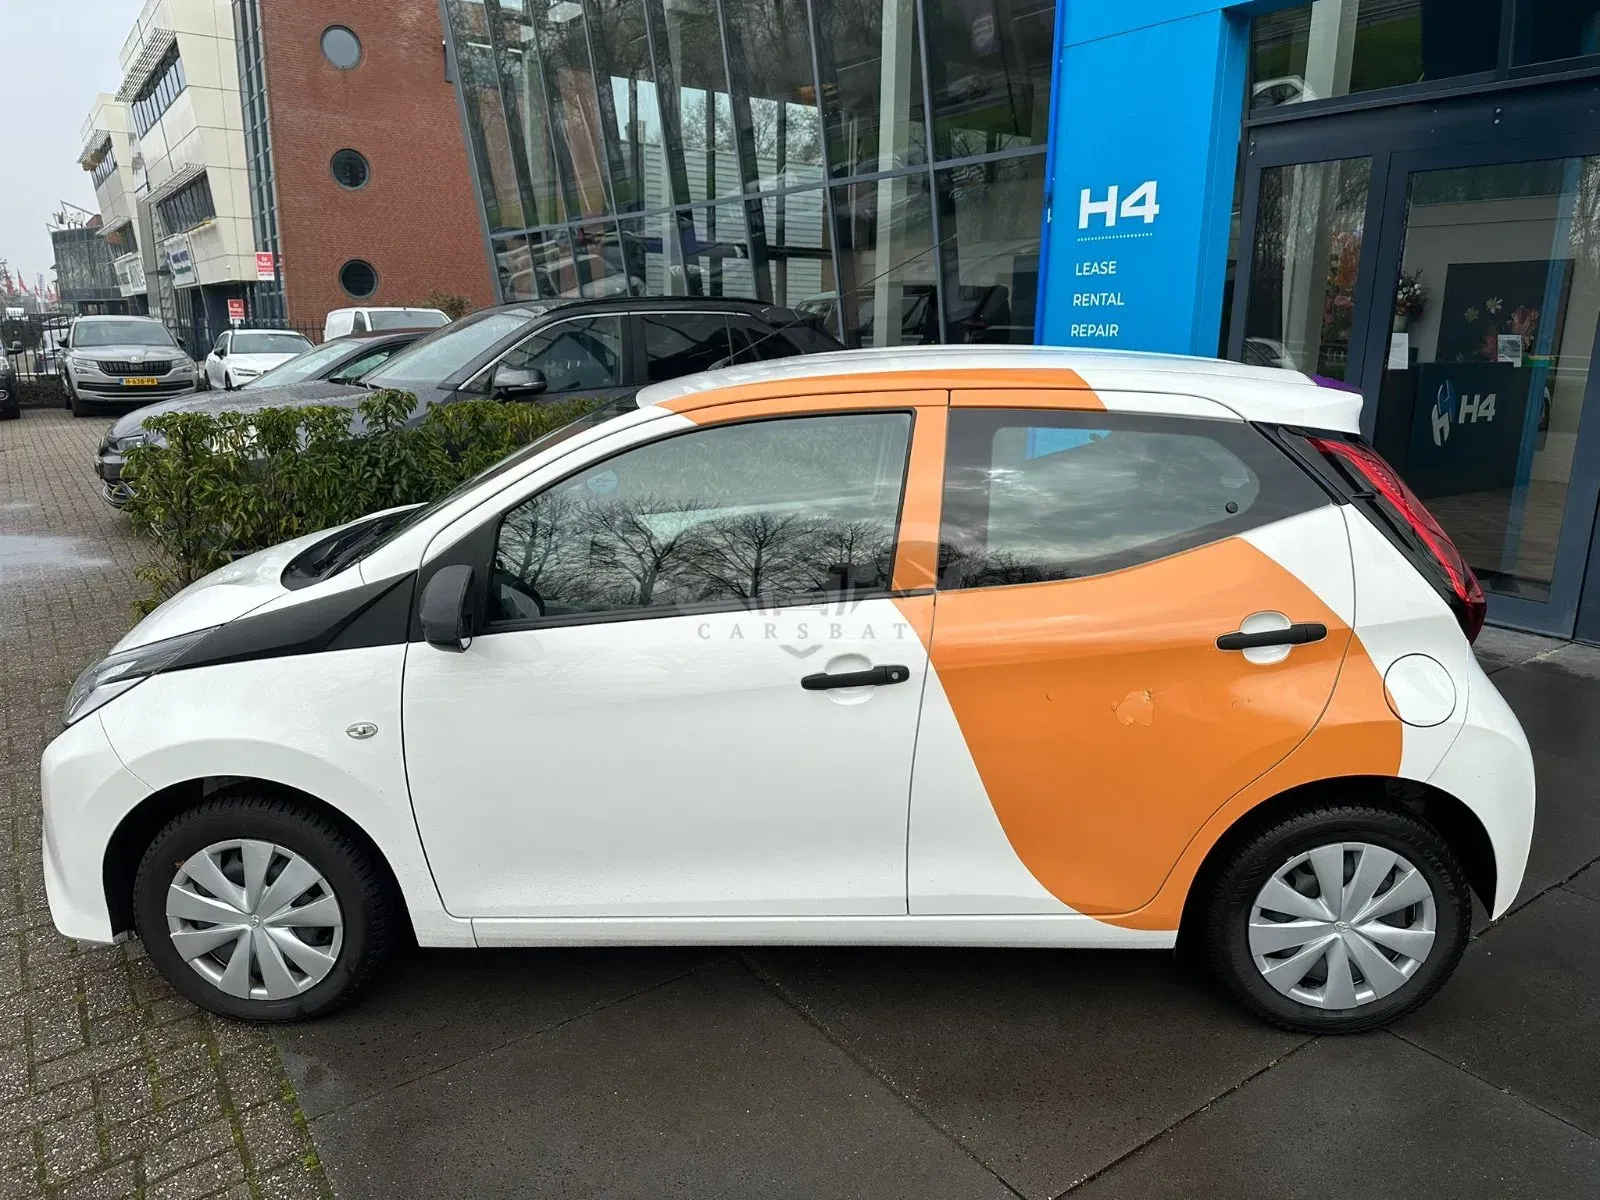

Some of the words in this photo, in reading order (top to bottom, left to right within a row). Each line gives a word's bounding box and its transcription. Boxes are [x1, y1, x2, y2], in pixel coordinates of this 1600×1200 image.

[1078, 180, 1160, 229] H4
[1075, 260, 1117, 276] LEASE
[1072, 292, 1125, 307] RENTAL
[1070, 323, 1119, 337] REPAIR
[1458, 393, 1497, 424] H4
